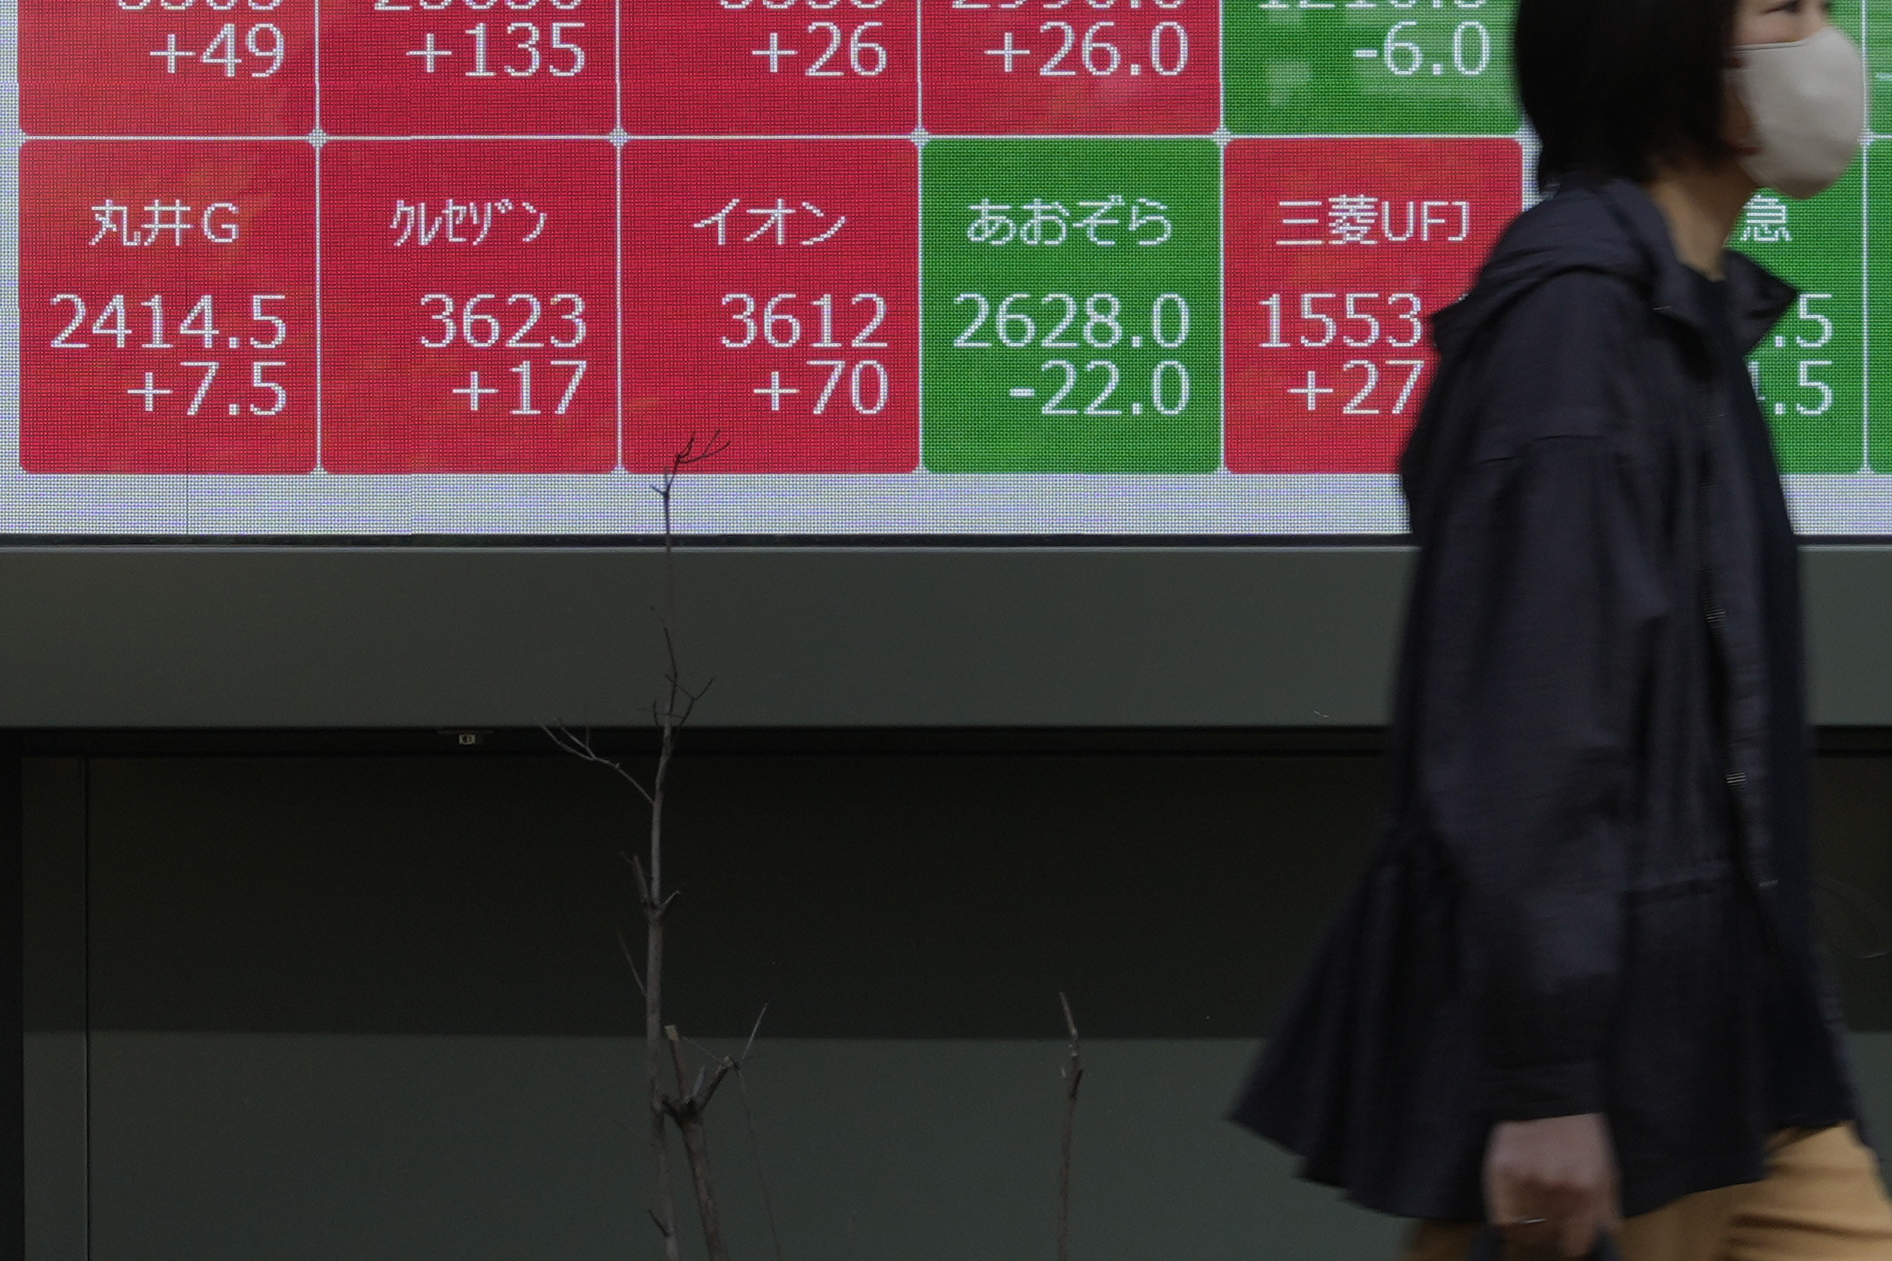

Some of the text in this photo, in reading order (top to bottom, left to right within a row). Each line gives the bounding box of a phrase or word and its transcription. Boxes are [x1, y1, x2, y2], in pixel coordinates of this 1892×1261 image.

[148, 20, 287, 80] +49
[405, 19, 588, 80] +135
[749, 18, 889, 80] +26
[983, 19, 1191, 79] +26.0
[1353, 19, 1493, 79] -6.0
[88, 197, 241, 249] 丸井G
[691, 196, 848, 248] イオン
[964, 193, 1174, 248] あおぞら
[1274, 192, 1472, 248] 三菱UFJ
[49, 292, 289, 352] 2414.5
[418, 290, 589, 351] 3623
[718, 290, 889, 351] 3612
[951, 291, 1192, 350] 2628.0
[125, 358, 289, 418] +7.5
[450, 357, 590, 417] +17
[751, 357, 890, 417] +70
[1007, 357, 1192, 417] -22.0
